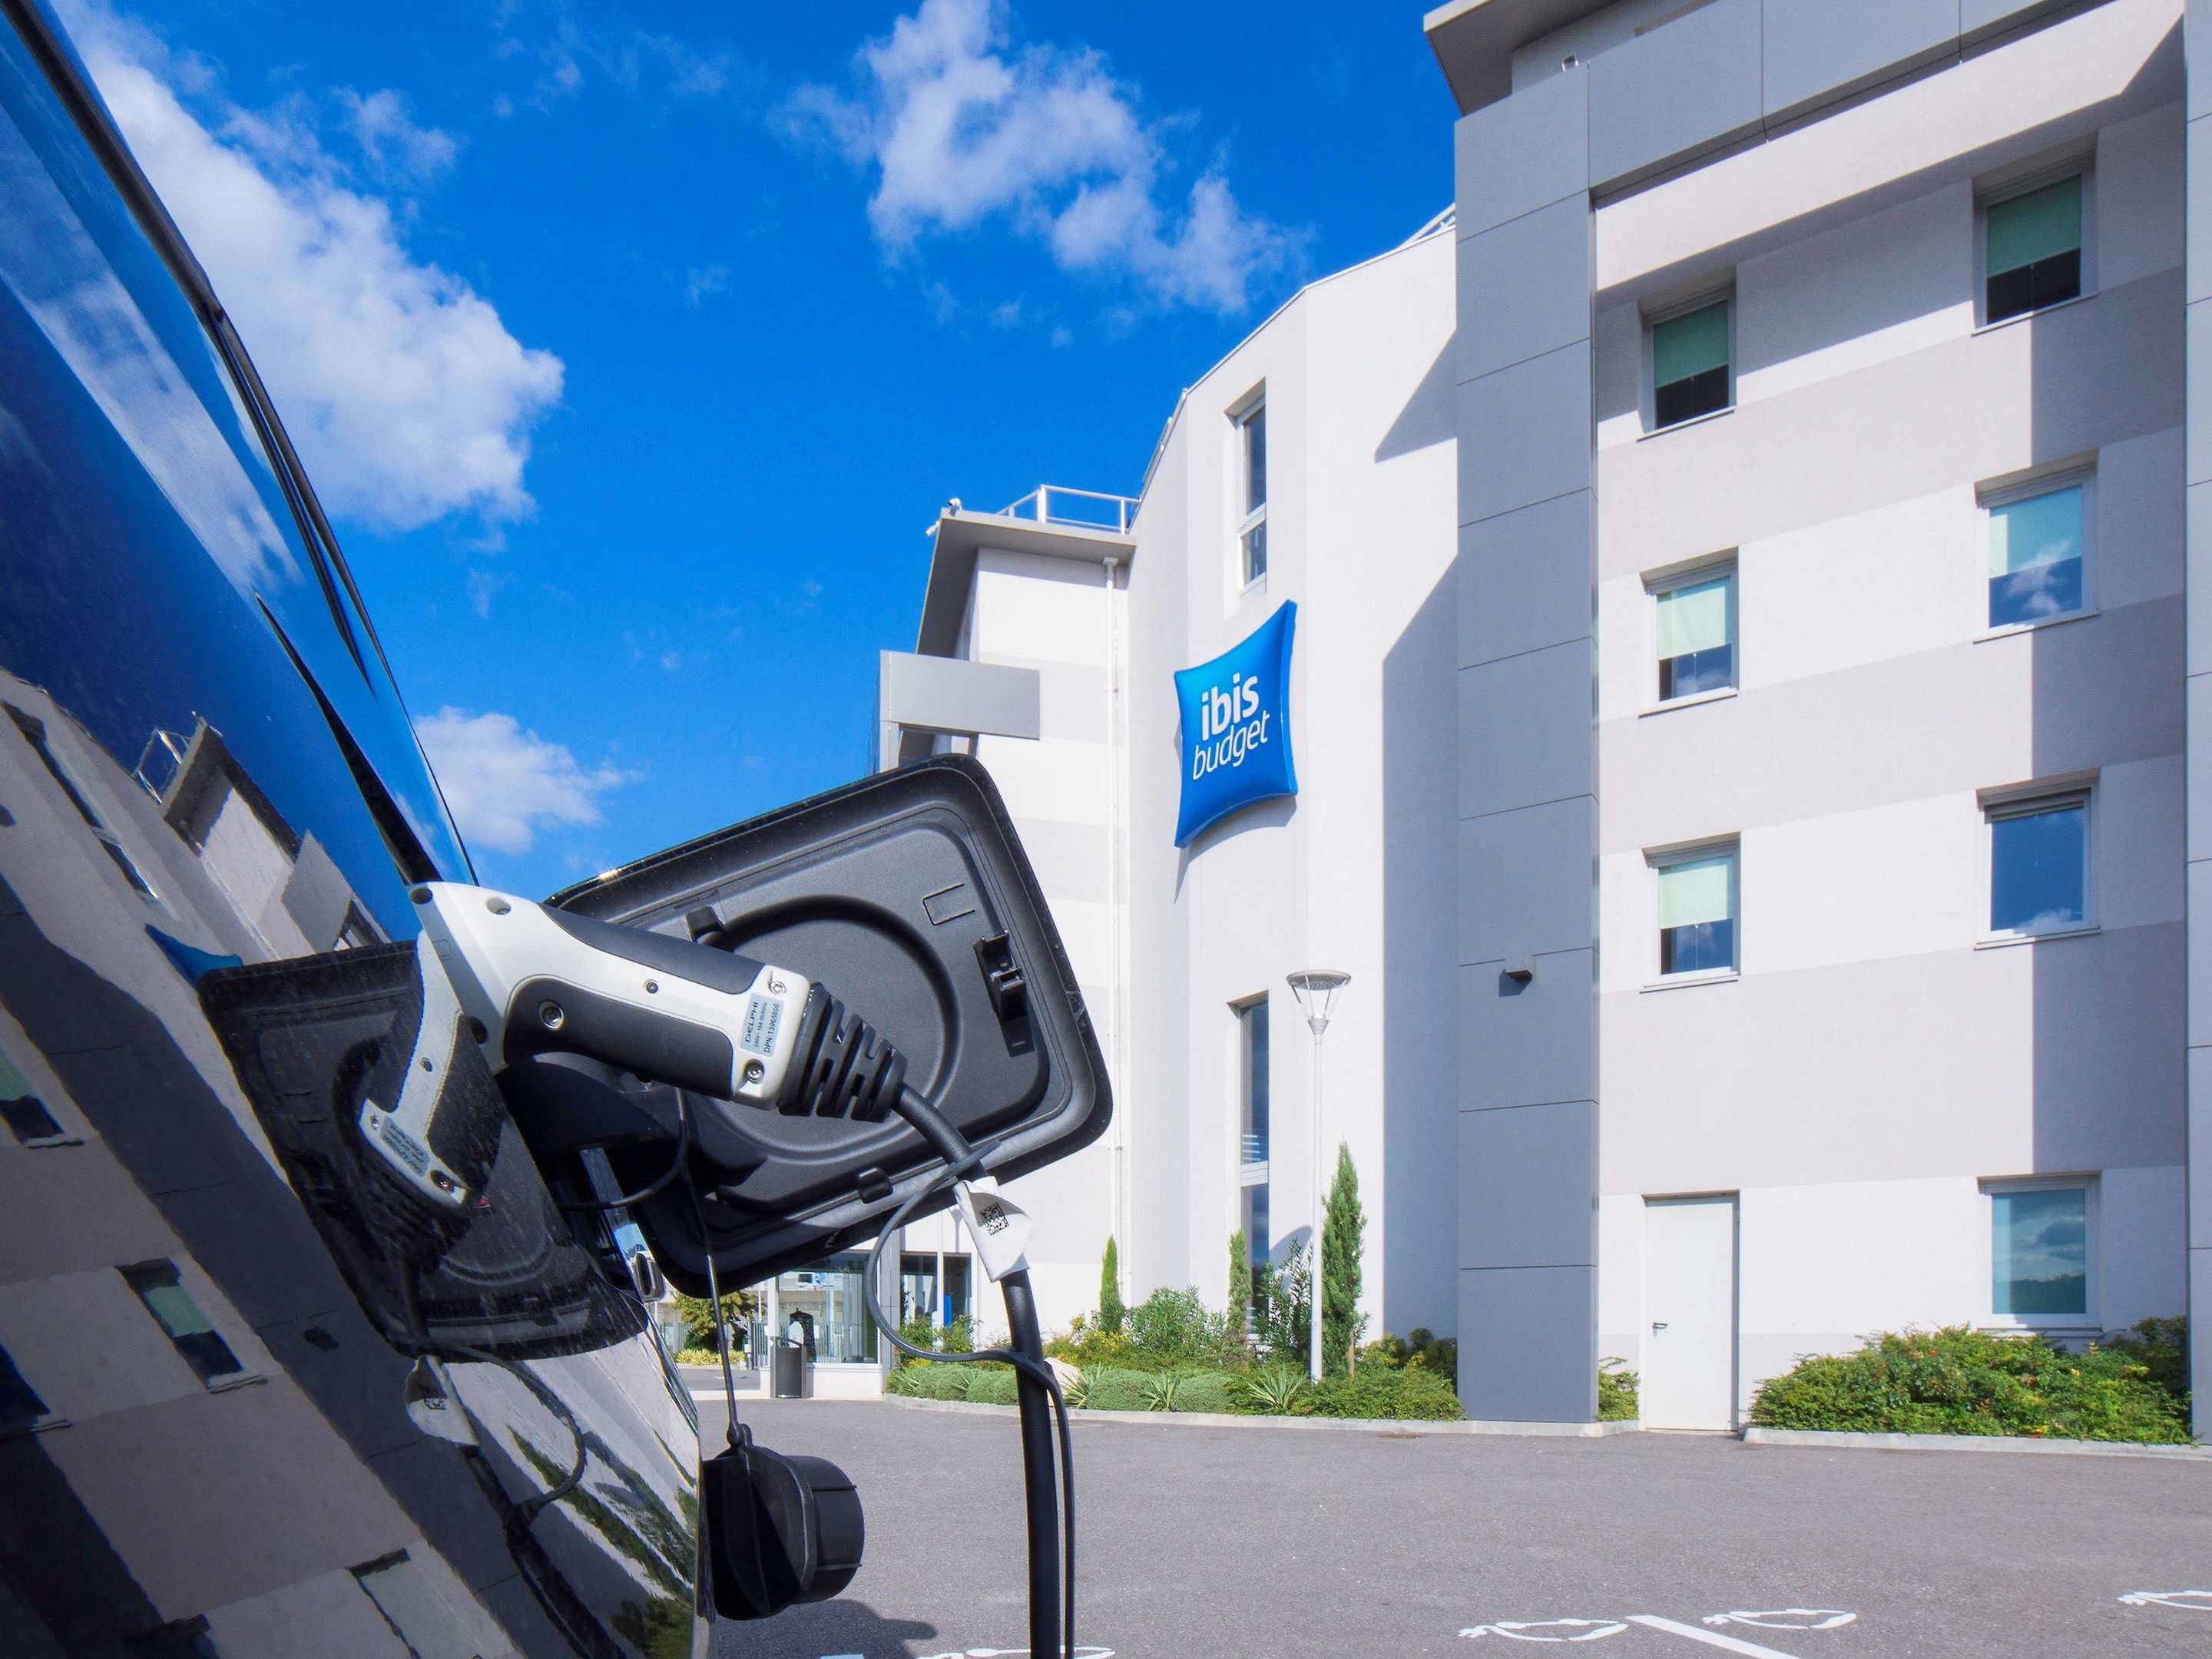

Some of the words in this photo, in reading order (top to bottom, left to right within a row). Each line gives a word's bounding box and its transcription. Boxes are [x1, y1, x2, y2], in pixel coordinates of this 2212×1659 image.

[1202, 672, 1260, 741] ibis
[1193, 710, 1270, 780] budget
[745, 1002, 758, 1043] DELPHI
